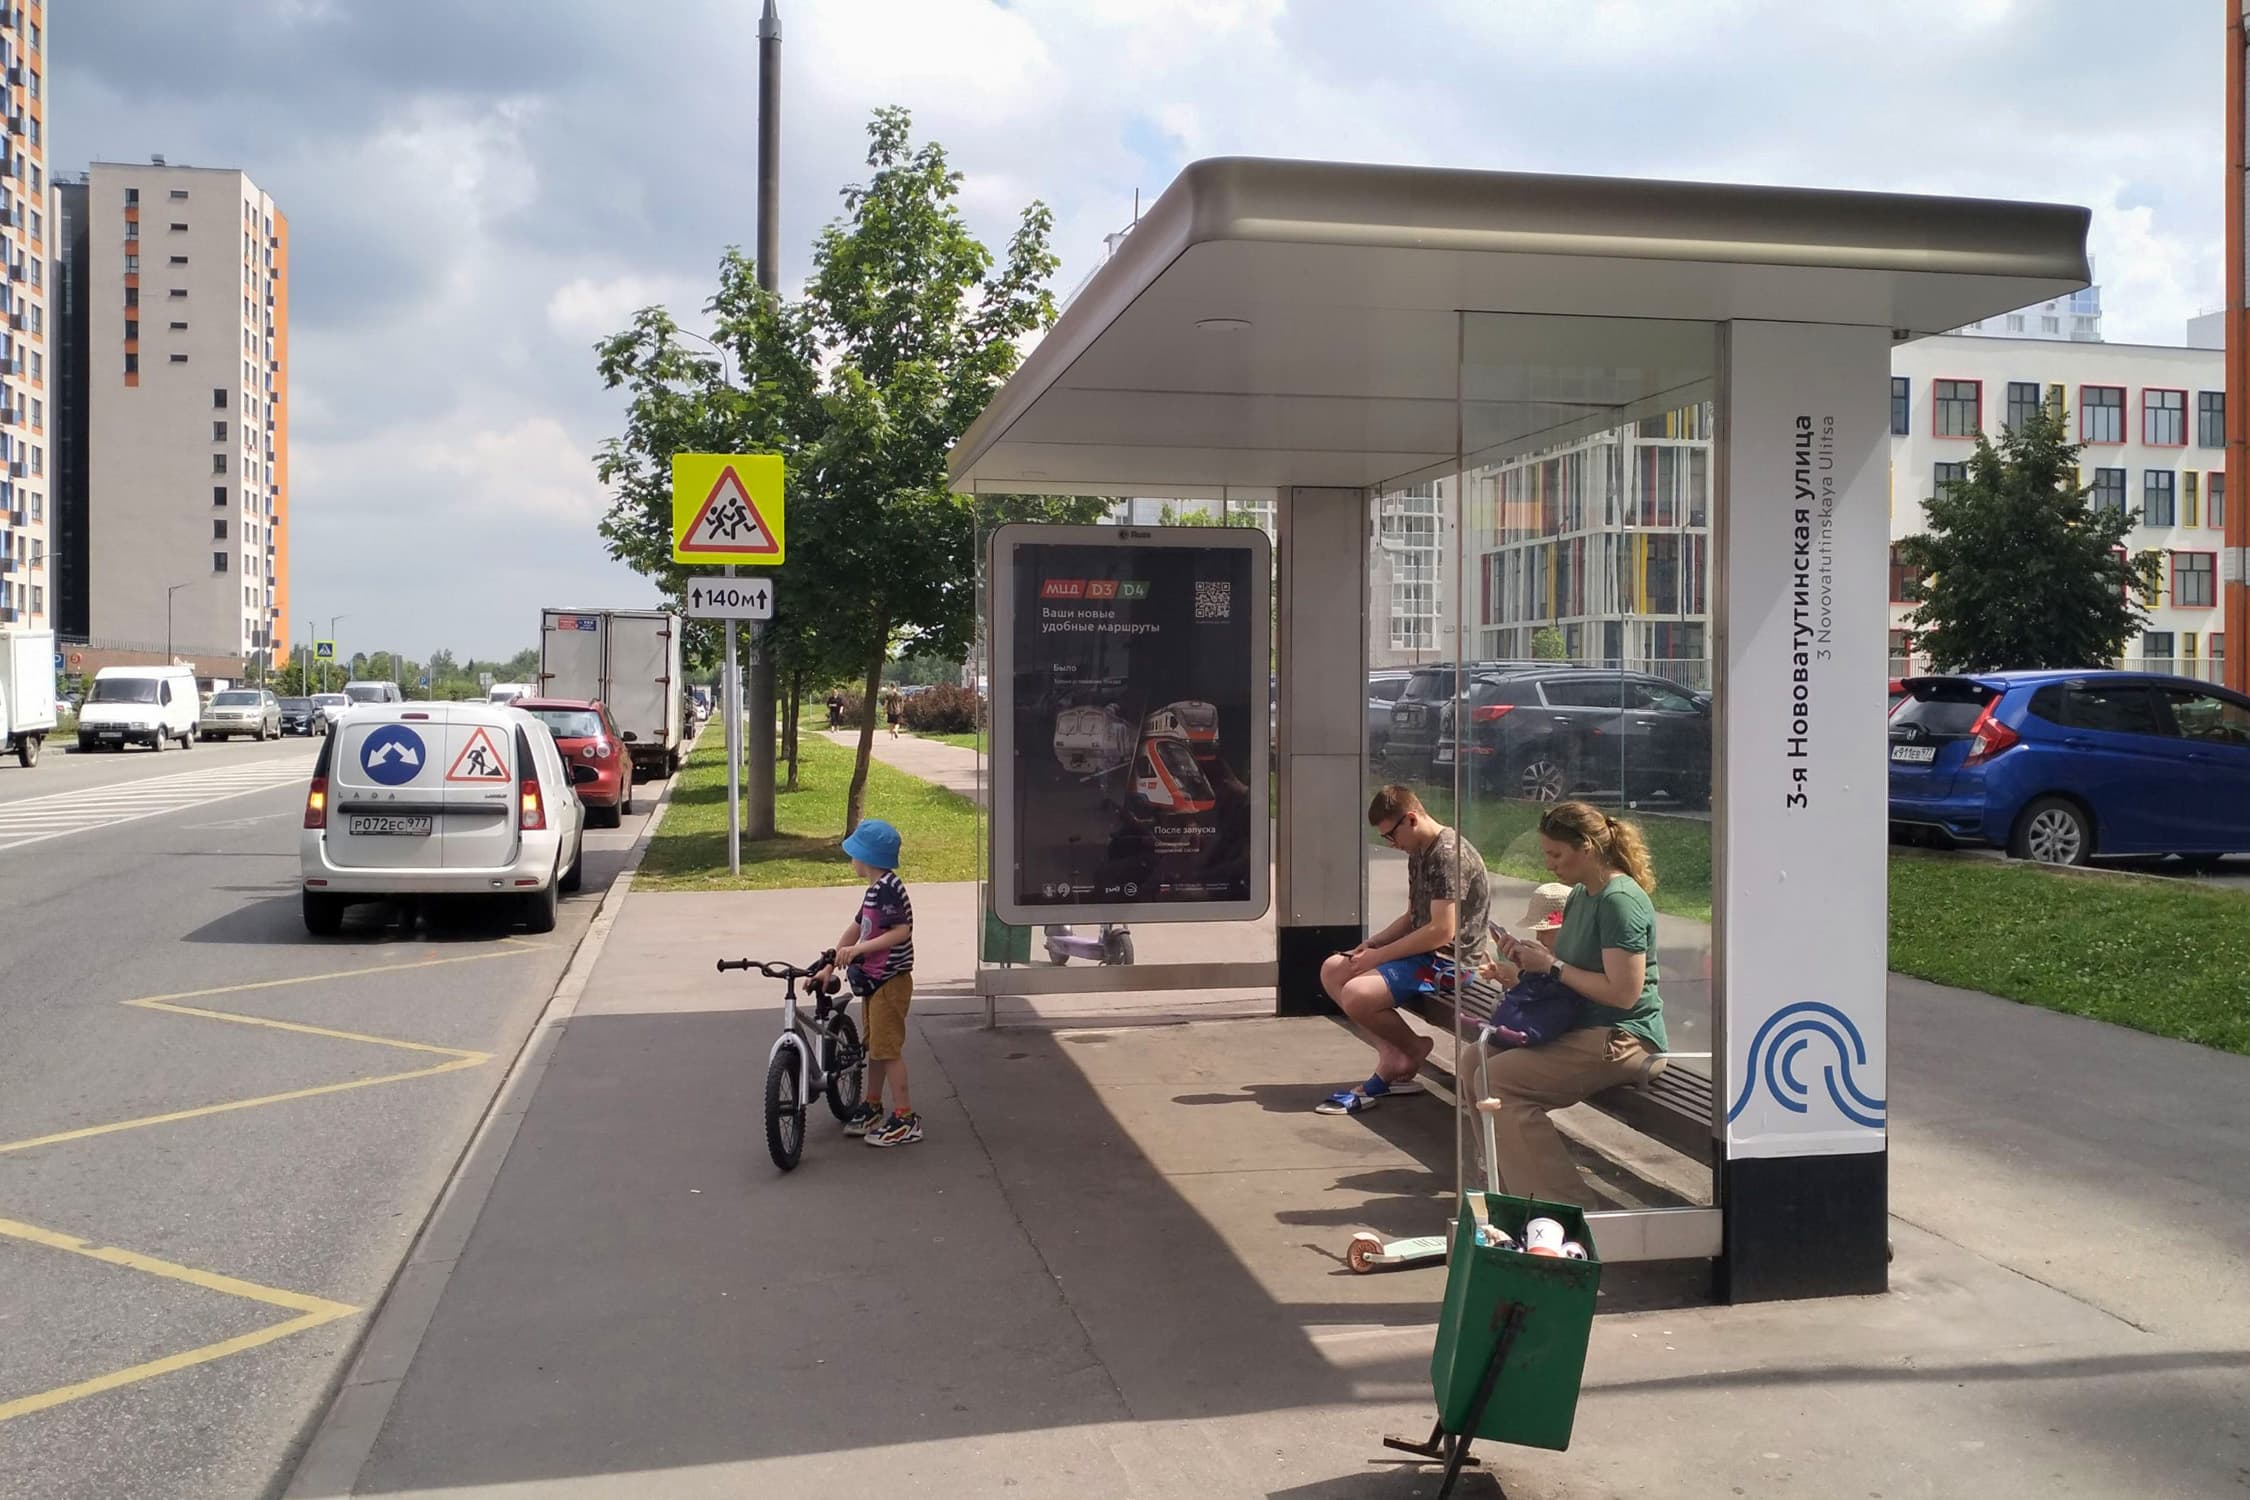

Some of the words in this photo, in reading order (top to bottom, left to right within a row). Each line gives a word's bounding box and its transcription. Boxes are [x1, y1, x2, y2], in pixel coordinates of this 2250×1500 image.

[1819, 415, 1834, 470] Ulitsa
[1795, 415, 1815, 500] улица
[1817, 477, 1836, 643] Novovatutinskaya
[1046, 583, 1080, 596] МЦД
[1091, 583, 1113, 596] D3
[1123, 584, 1145, 596] D4
[1042, 607, 1075, 618] Ваши
[1077, 609, 1116, 619] новые
[1042, 620, 1095, 633] удобные
[1097, 622, 1161, 634] маршруты
[1787, 509, 1814, 757] Нововатутинская
[1817, 649, 1831, 660] 3
[1786, 768, 1808, 809] 3-я
[1153, 825, 1182, 834] После
[1183, 826, 1217, 836] запуска
